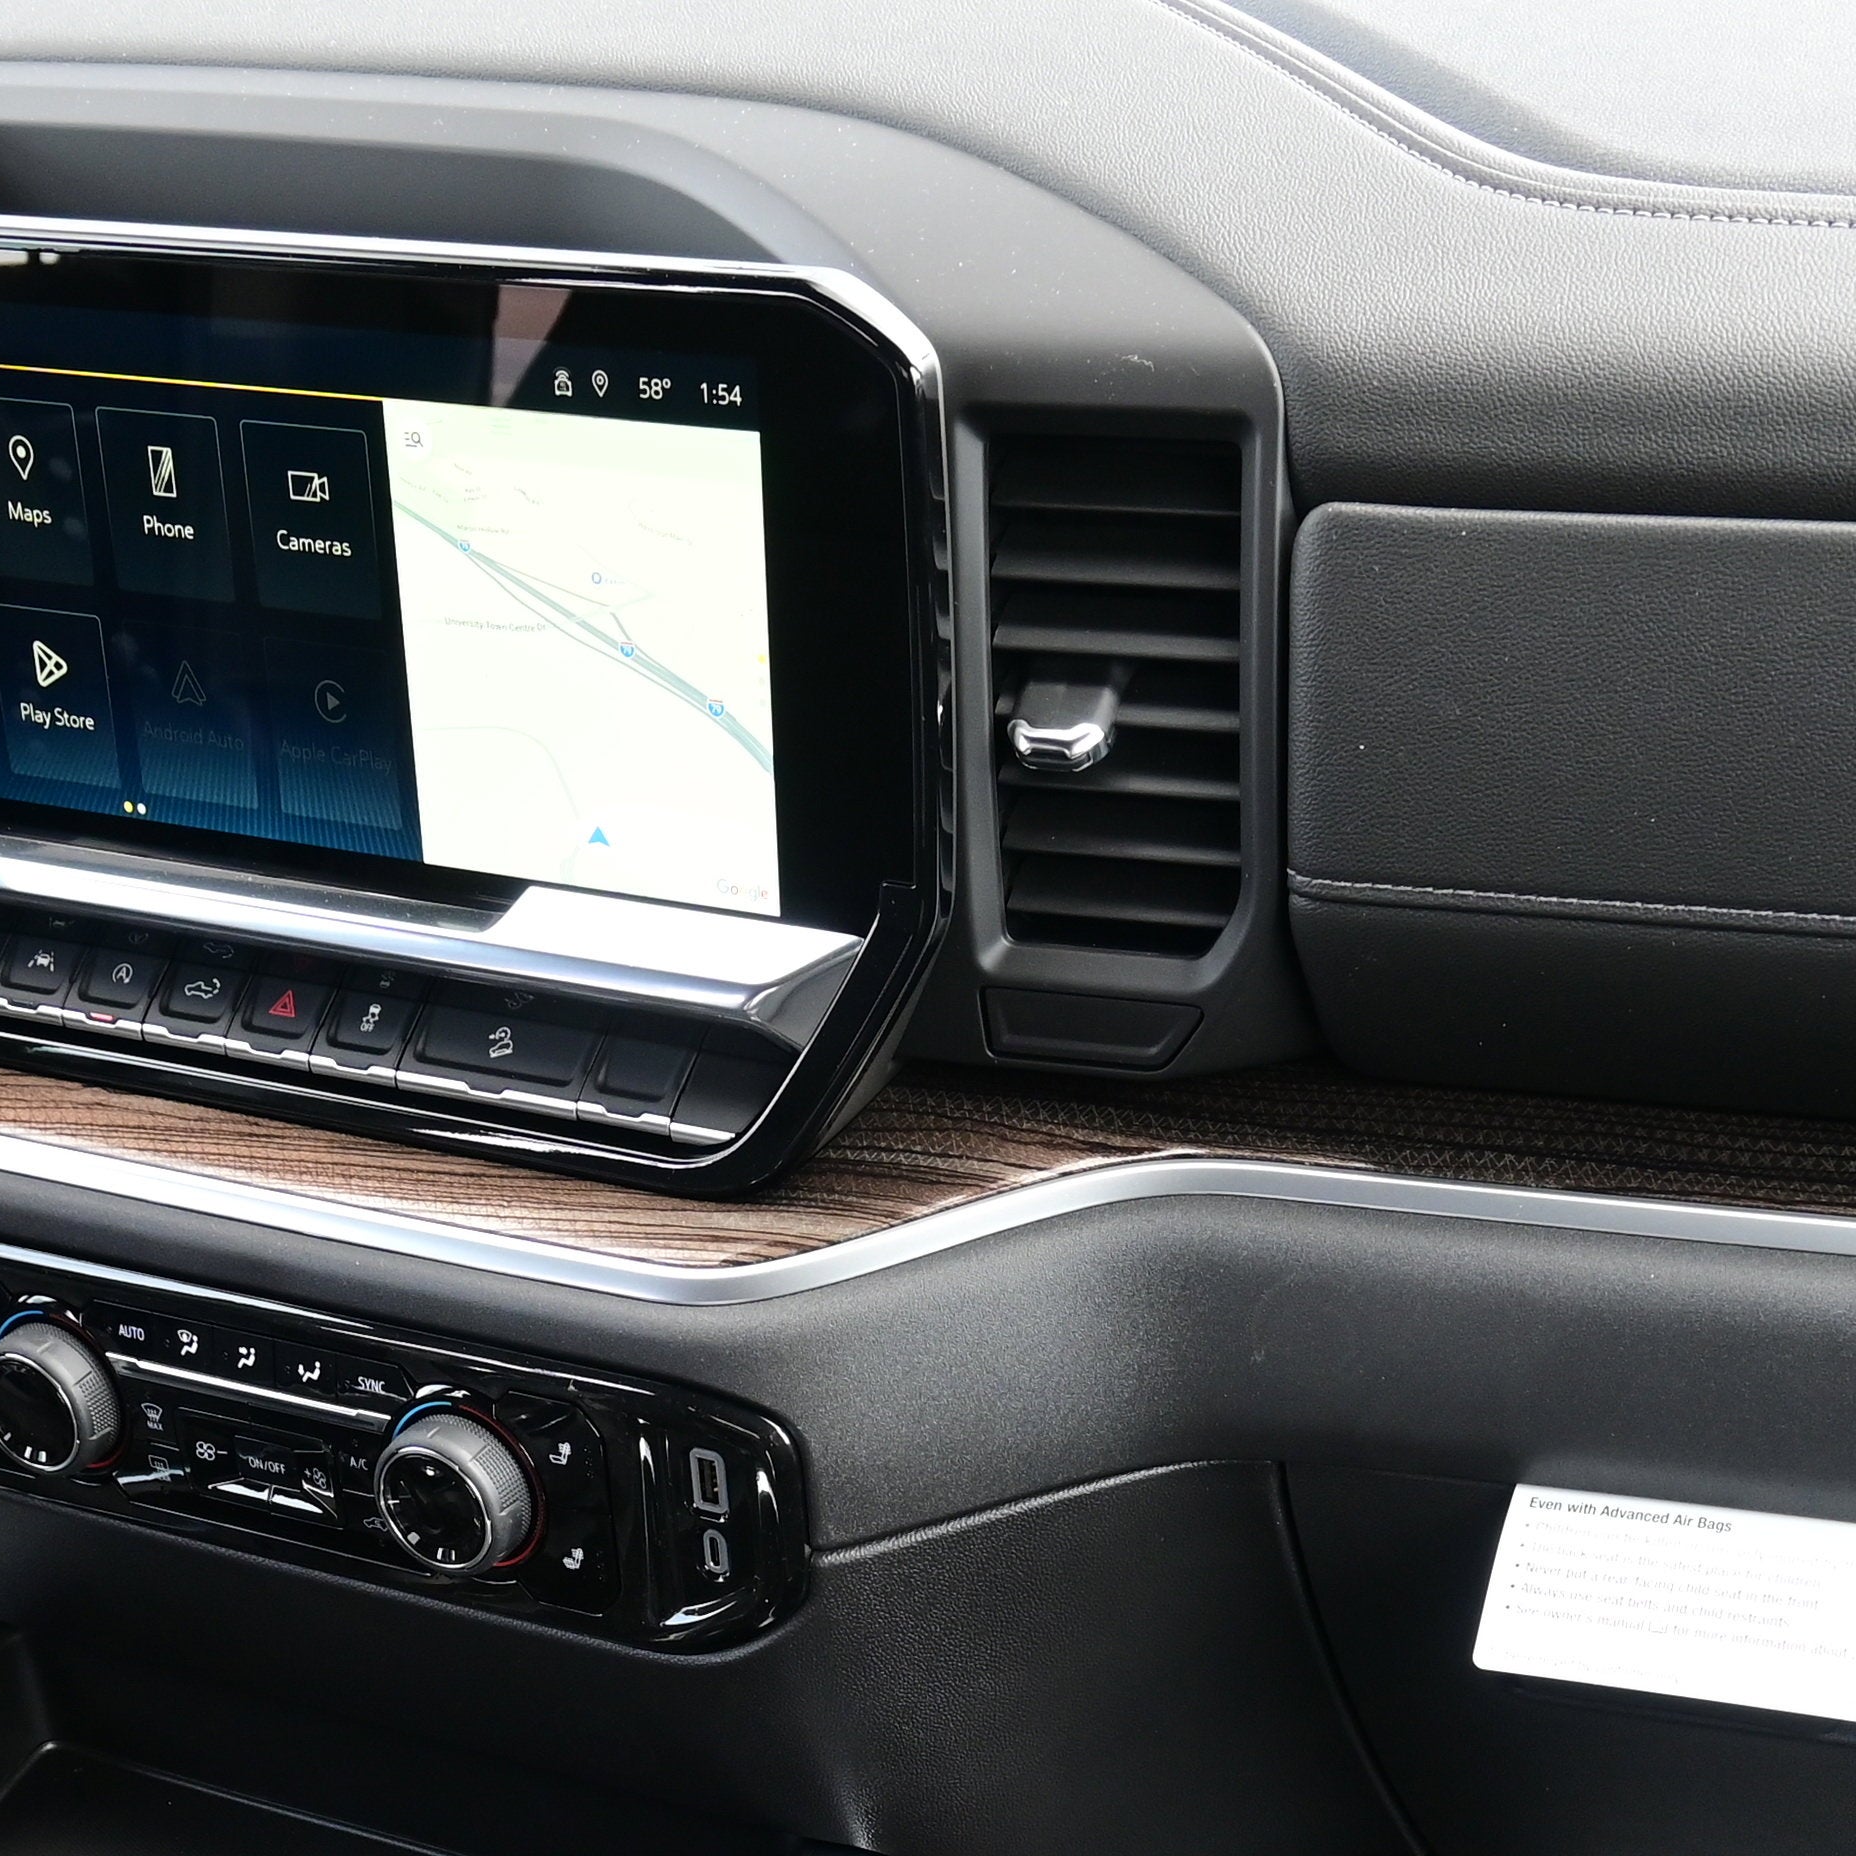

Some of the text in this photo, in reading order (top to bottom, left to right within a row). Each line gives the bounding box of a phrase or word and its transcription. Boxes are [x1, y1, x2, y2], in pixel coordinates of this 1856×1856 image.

[700, 382, 743, 408] 1:54
[8, 502, 52, 526] Maps
[143, 516, 195, 540] Phone
[276, 530, 352, 557] Cameras
[20, 704, 95, 731] Play Store
[144, 721, 244, 749] Android Auto
[280, 740, 392, 775] Apple CarPlay
[716, 878, 768, 901] Gogle
[119, 1322, 145, 1341] AUTO
[357, 1375, 386, 1394] SYNC
[248, 1454, 286, 1474] ON/OFF
[349, 1454, 368, 1471] A/C
[1528, 1495, 1732, 1534] Even with Advanced Air Bags
